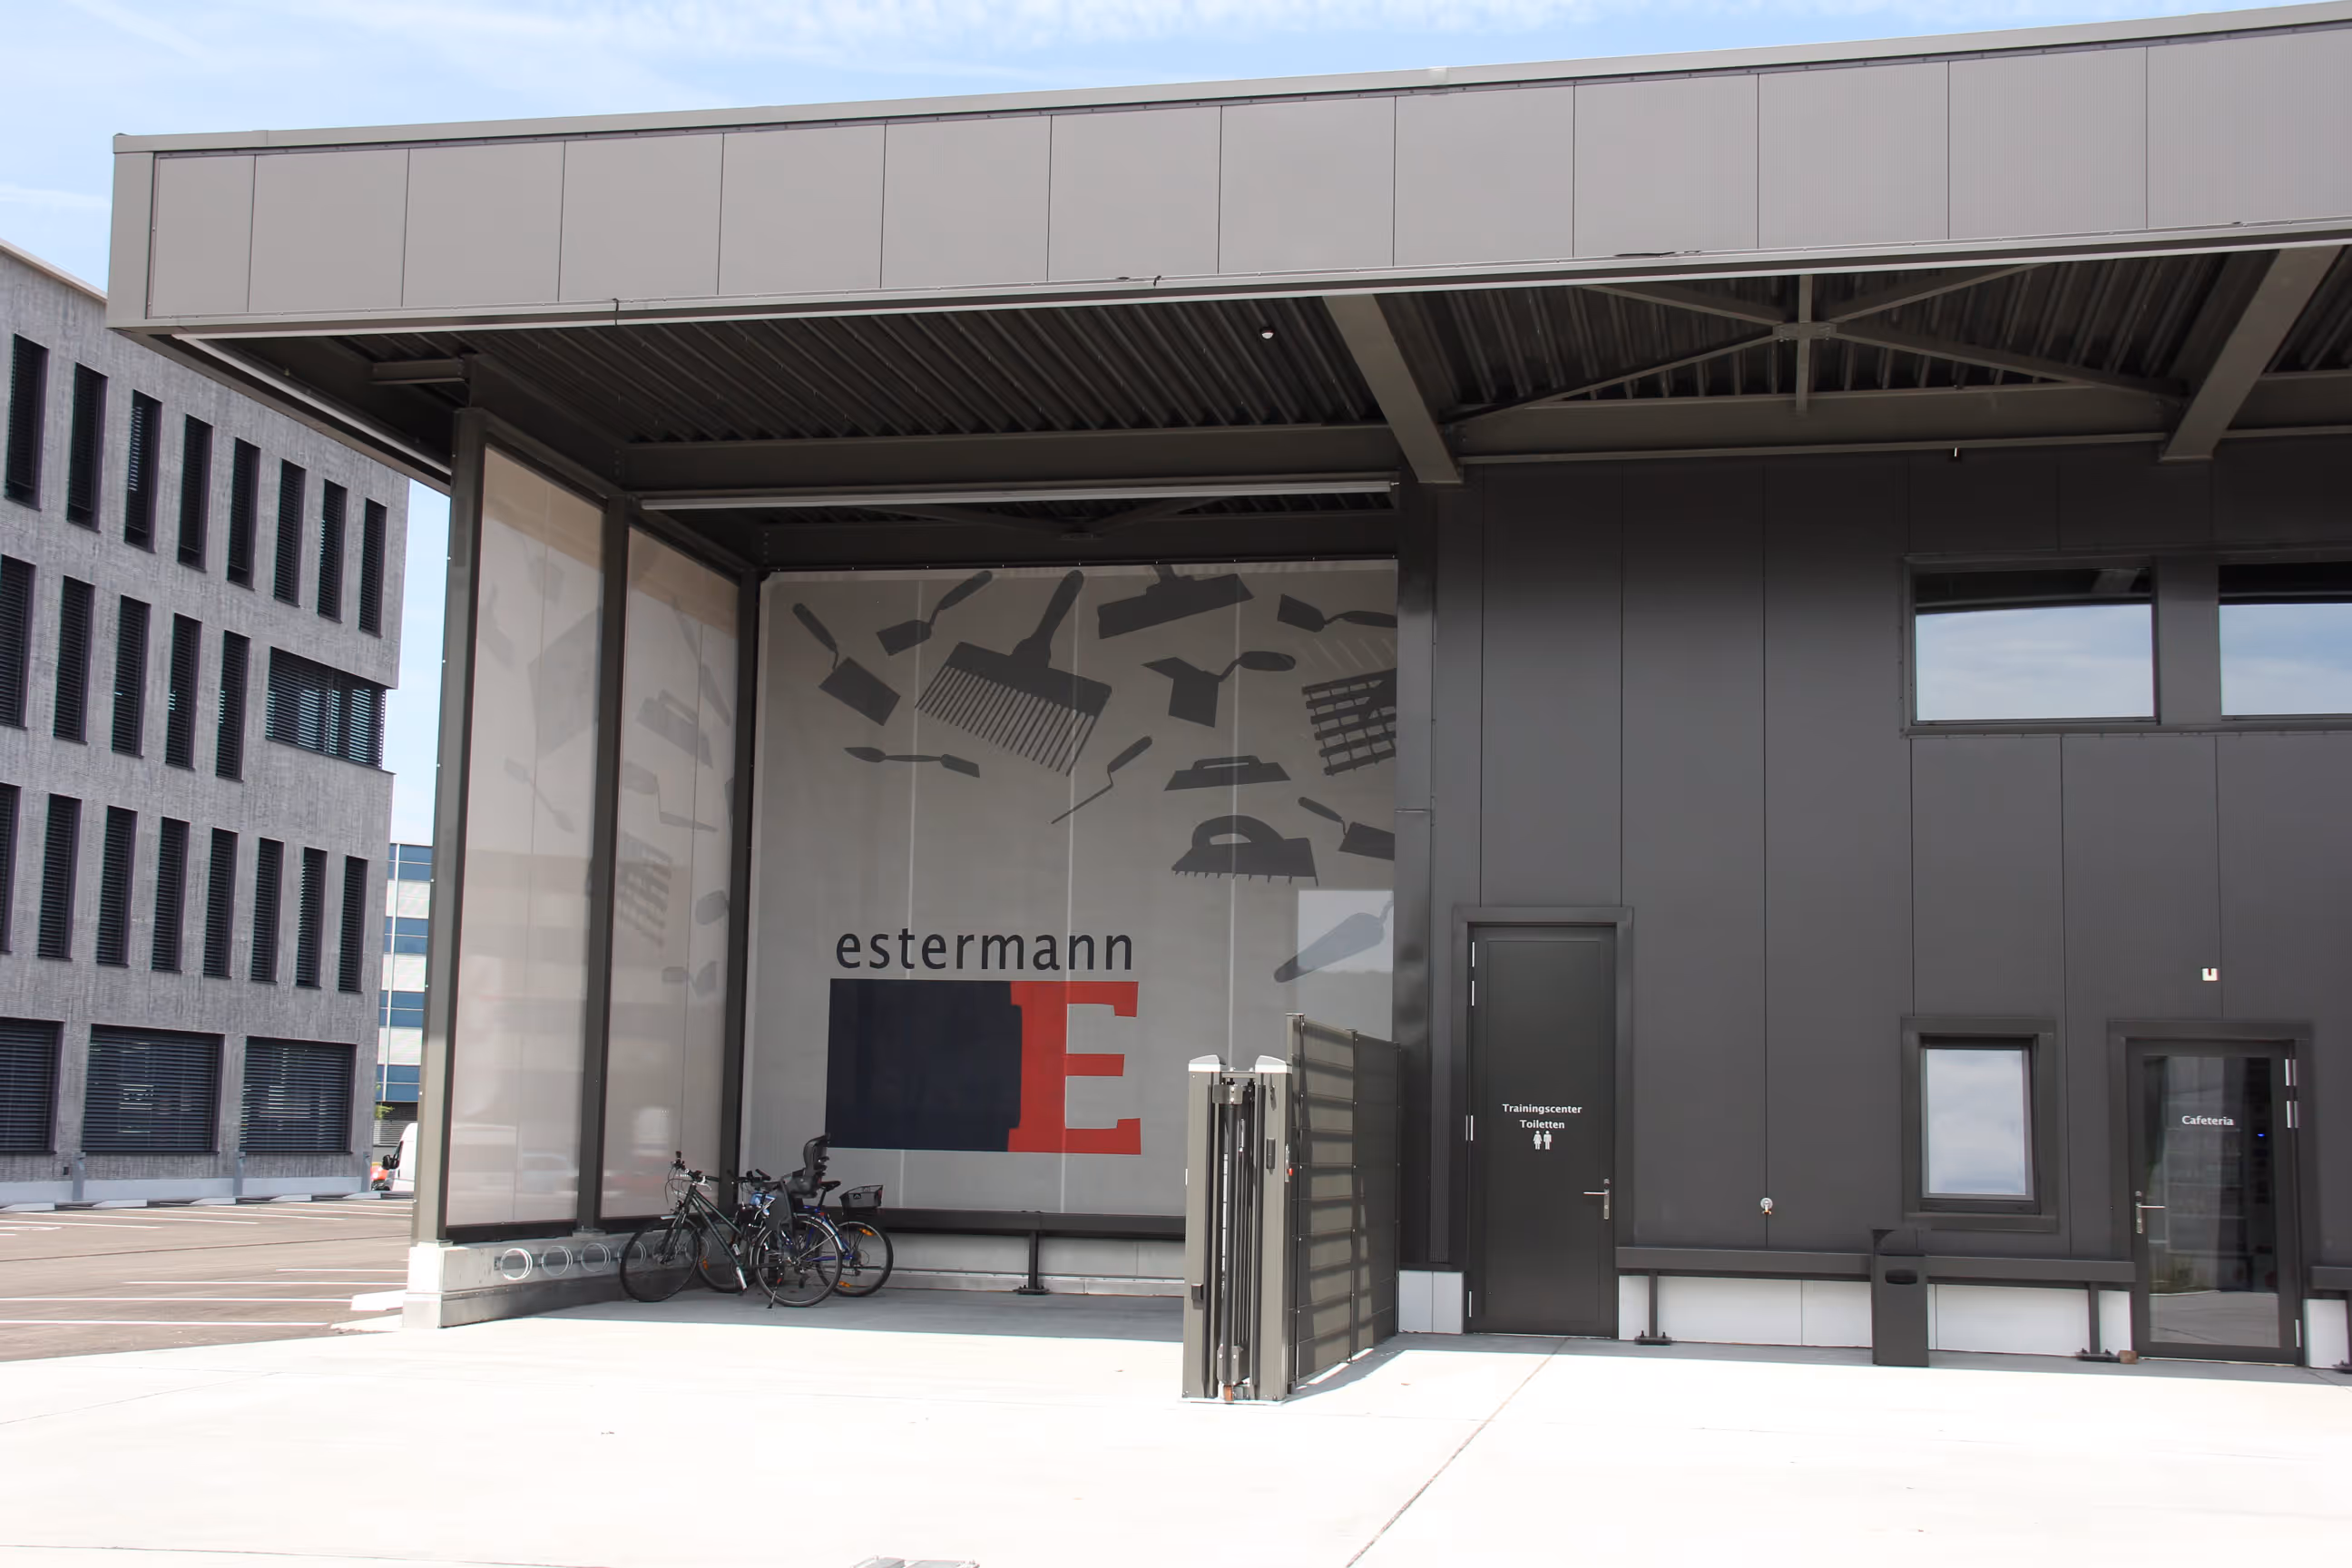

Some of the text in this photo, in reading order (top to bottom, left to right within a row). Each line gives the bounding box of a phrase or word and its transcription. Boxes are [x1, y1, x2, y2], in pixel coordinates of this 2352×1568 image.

[836, 928, 1133, 971] estermann
[1502, 1103, 1583, 1115] Trainingscenter
[1519, 1119, 1565, 1129] Toiletten
[2181, 1115, 2235, 1125] Cafeteria
